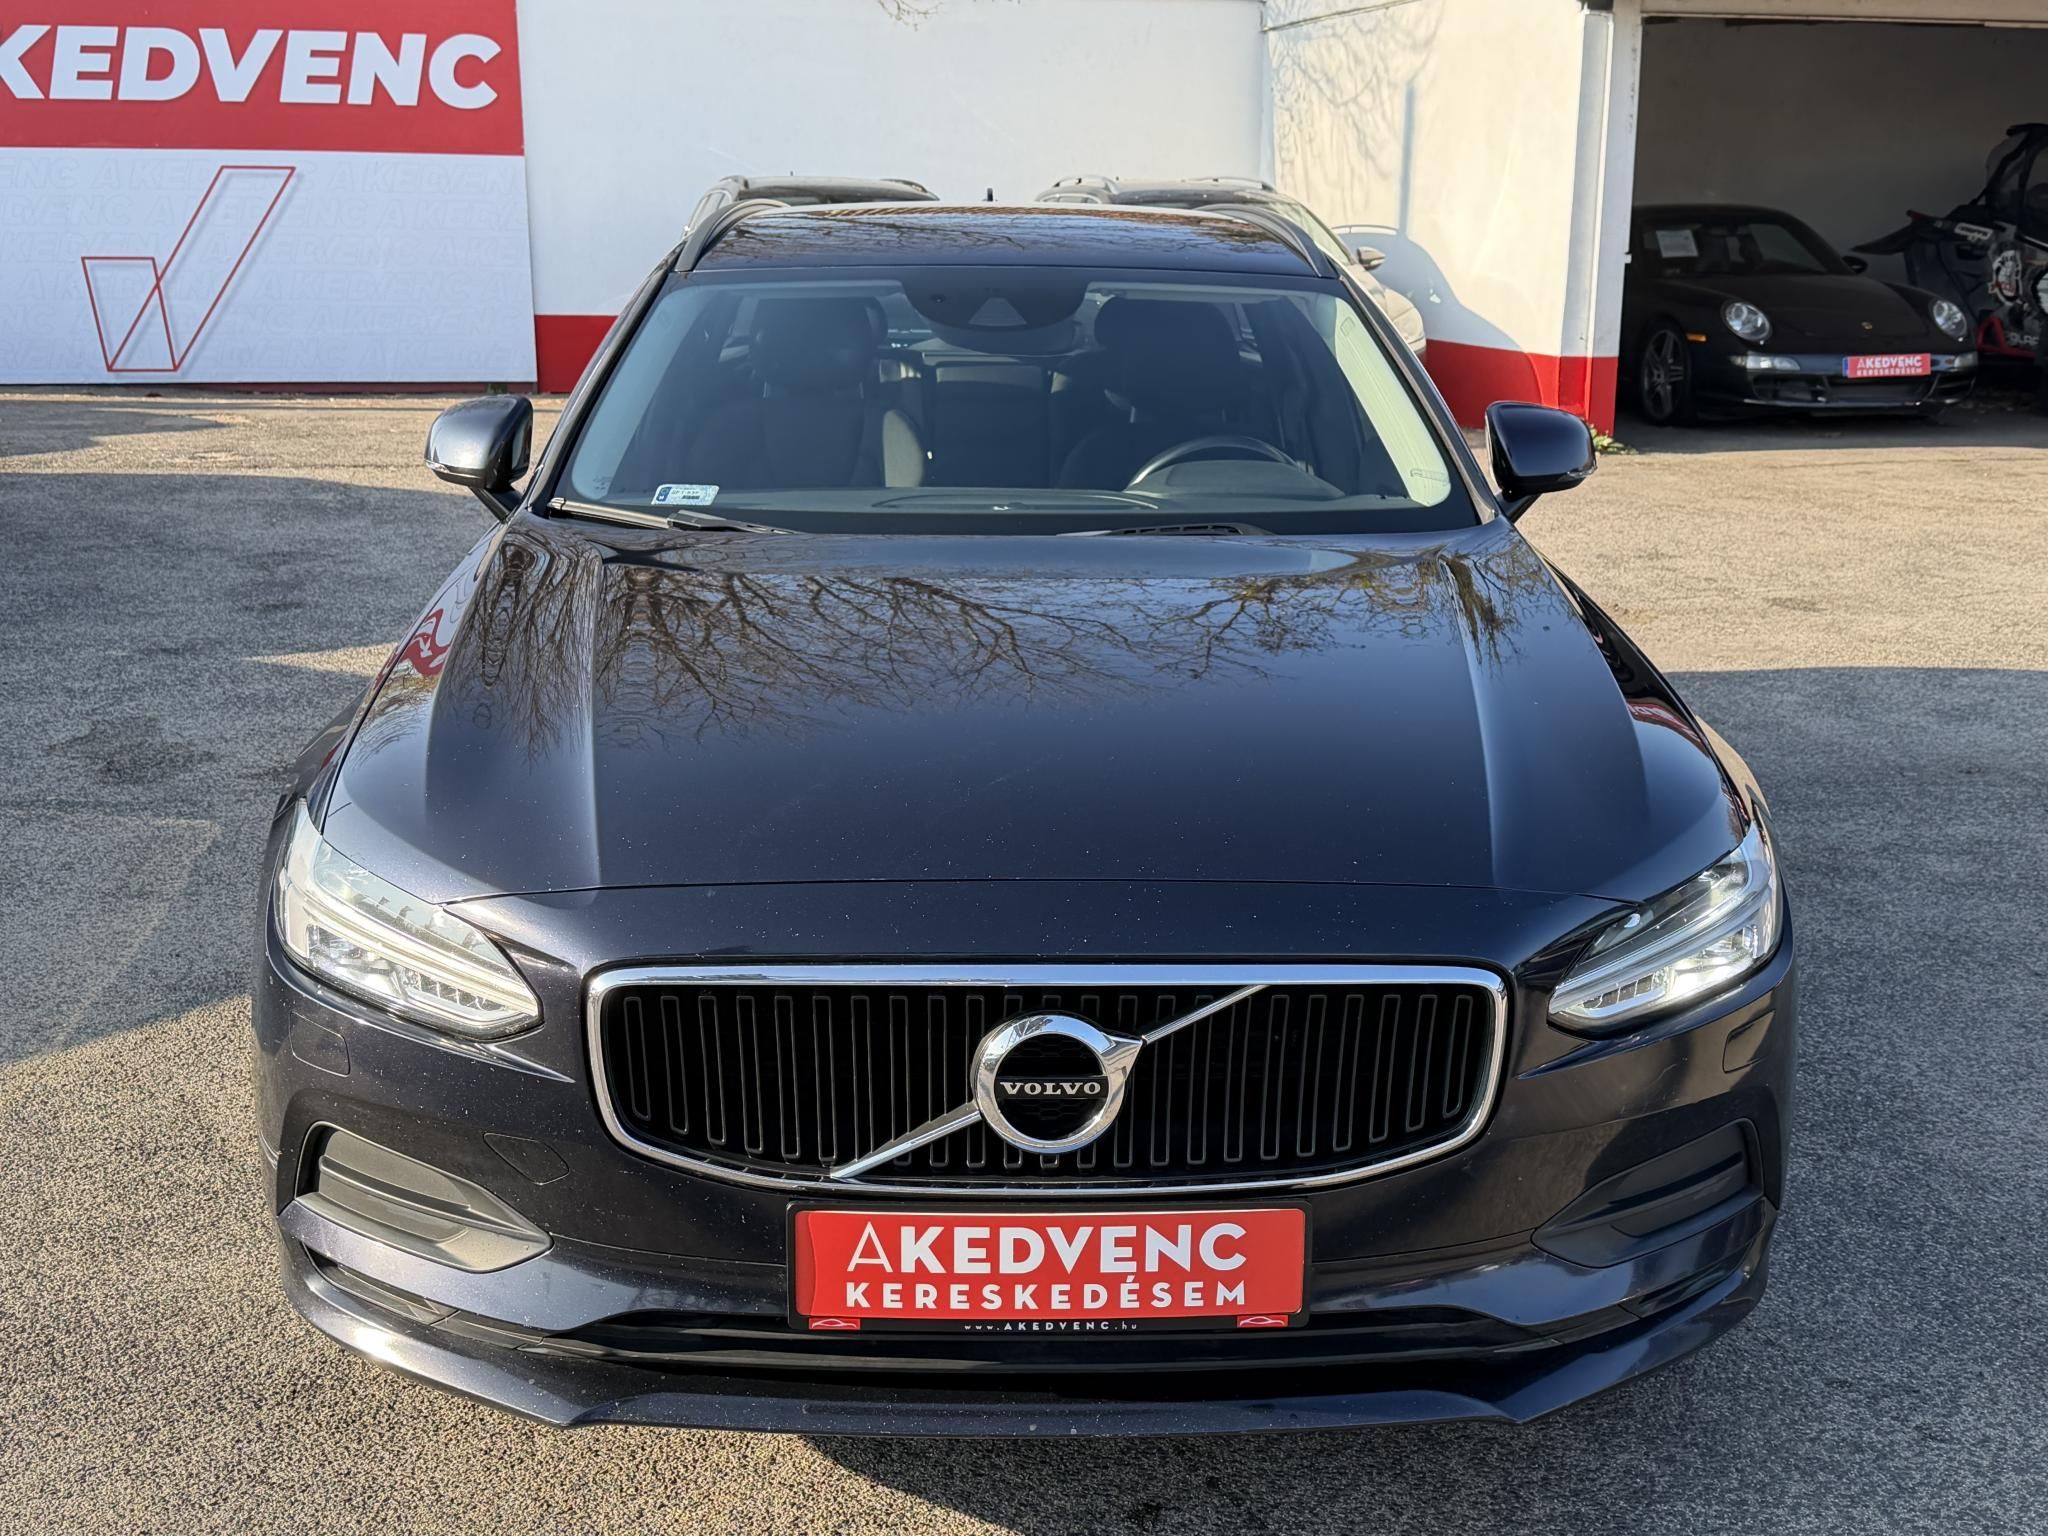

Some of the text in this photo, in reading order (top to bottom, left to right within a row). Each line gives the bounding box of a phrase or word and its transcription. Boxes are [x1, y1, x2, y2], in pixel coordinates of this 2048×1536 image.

[0, 25, 501, 109] KEDVENC
[1857, 356, 1922, 369] AKEDVENC
[1000, 1082, 1101, 1095] VOLVO
[847, 1221, 1247, 1275] AKEDVENC
[846, 1276, 1246, 1308] KERESKEDÉSEM
